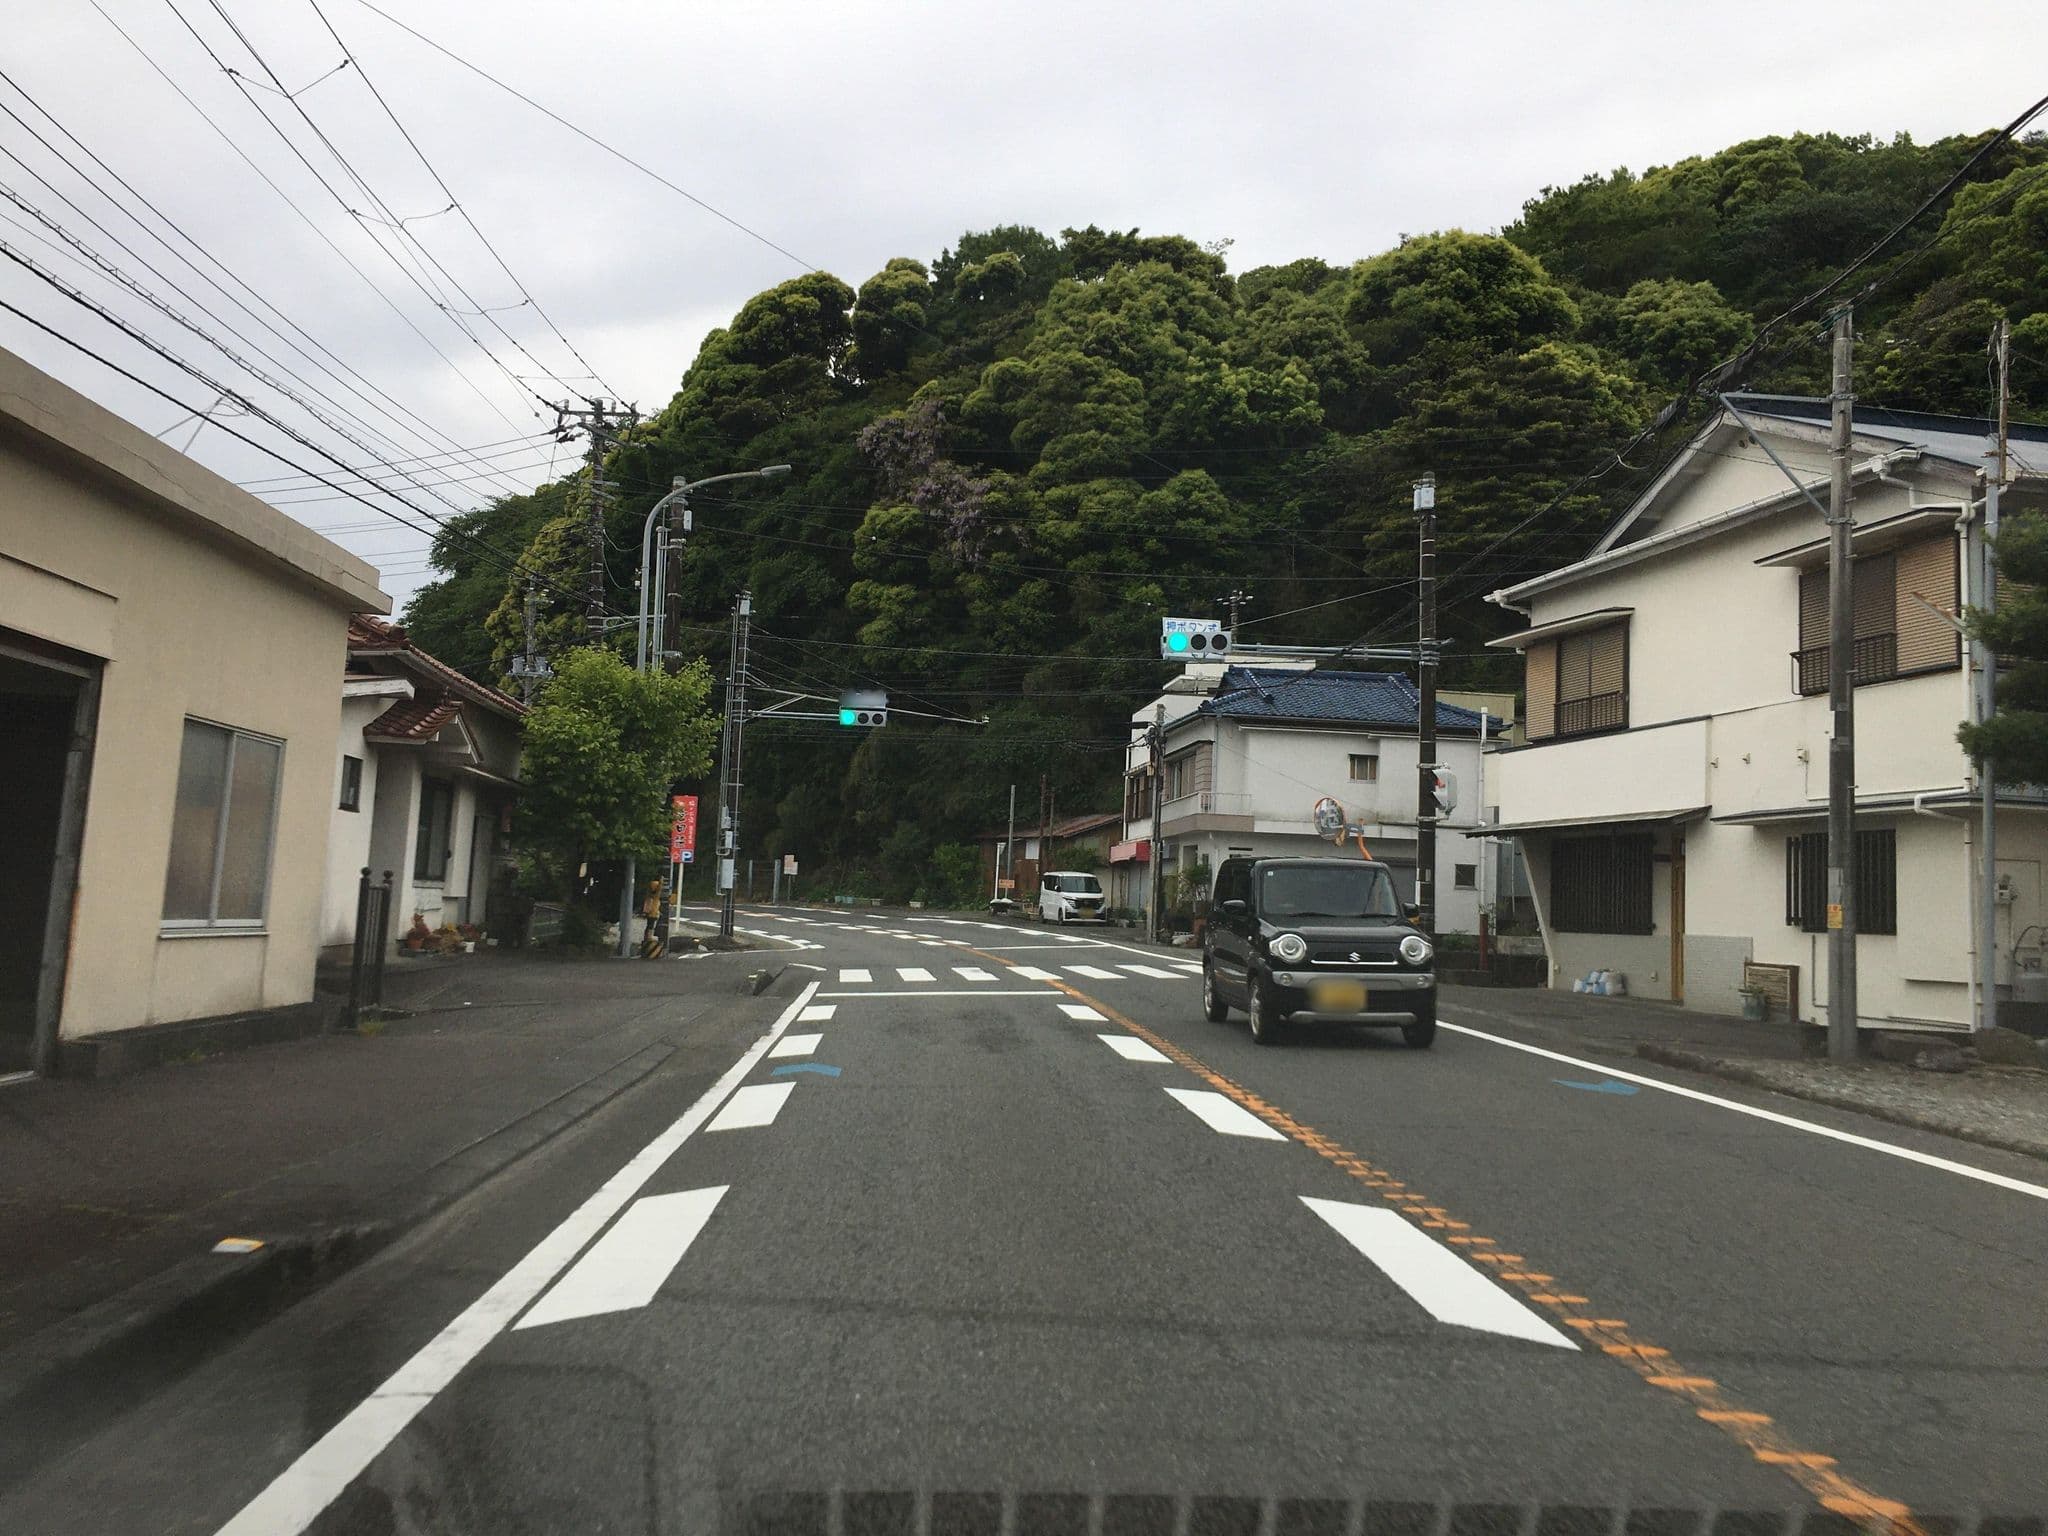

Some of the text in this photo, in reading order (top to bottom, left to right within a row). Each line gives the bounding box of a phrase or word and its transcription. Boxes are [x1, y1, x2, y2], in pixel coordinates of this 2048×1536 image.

[1167, 621, 1217, 632] 押ボタン式
[682, 851, 692, 862] P
